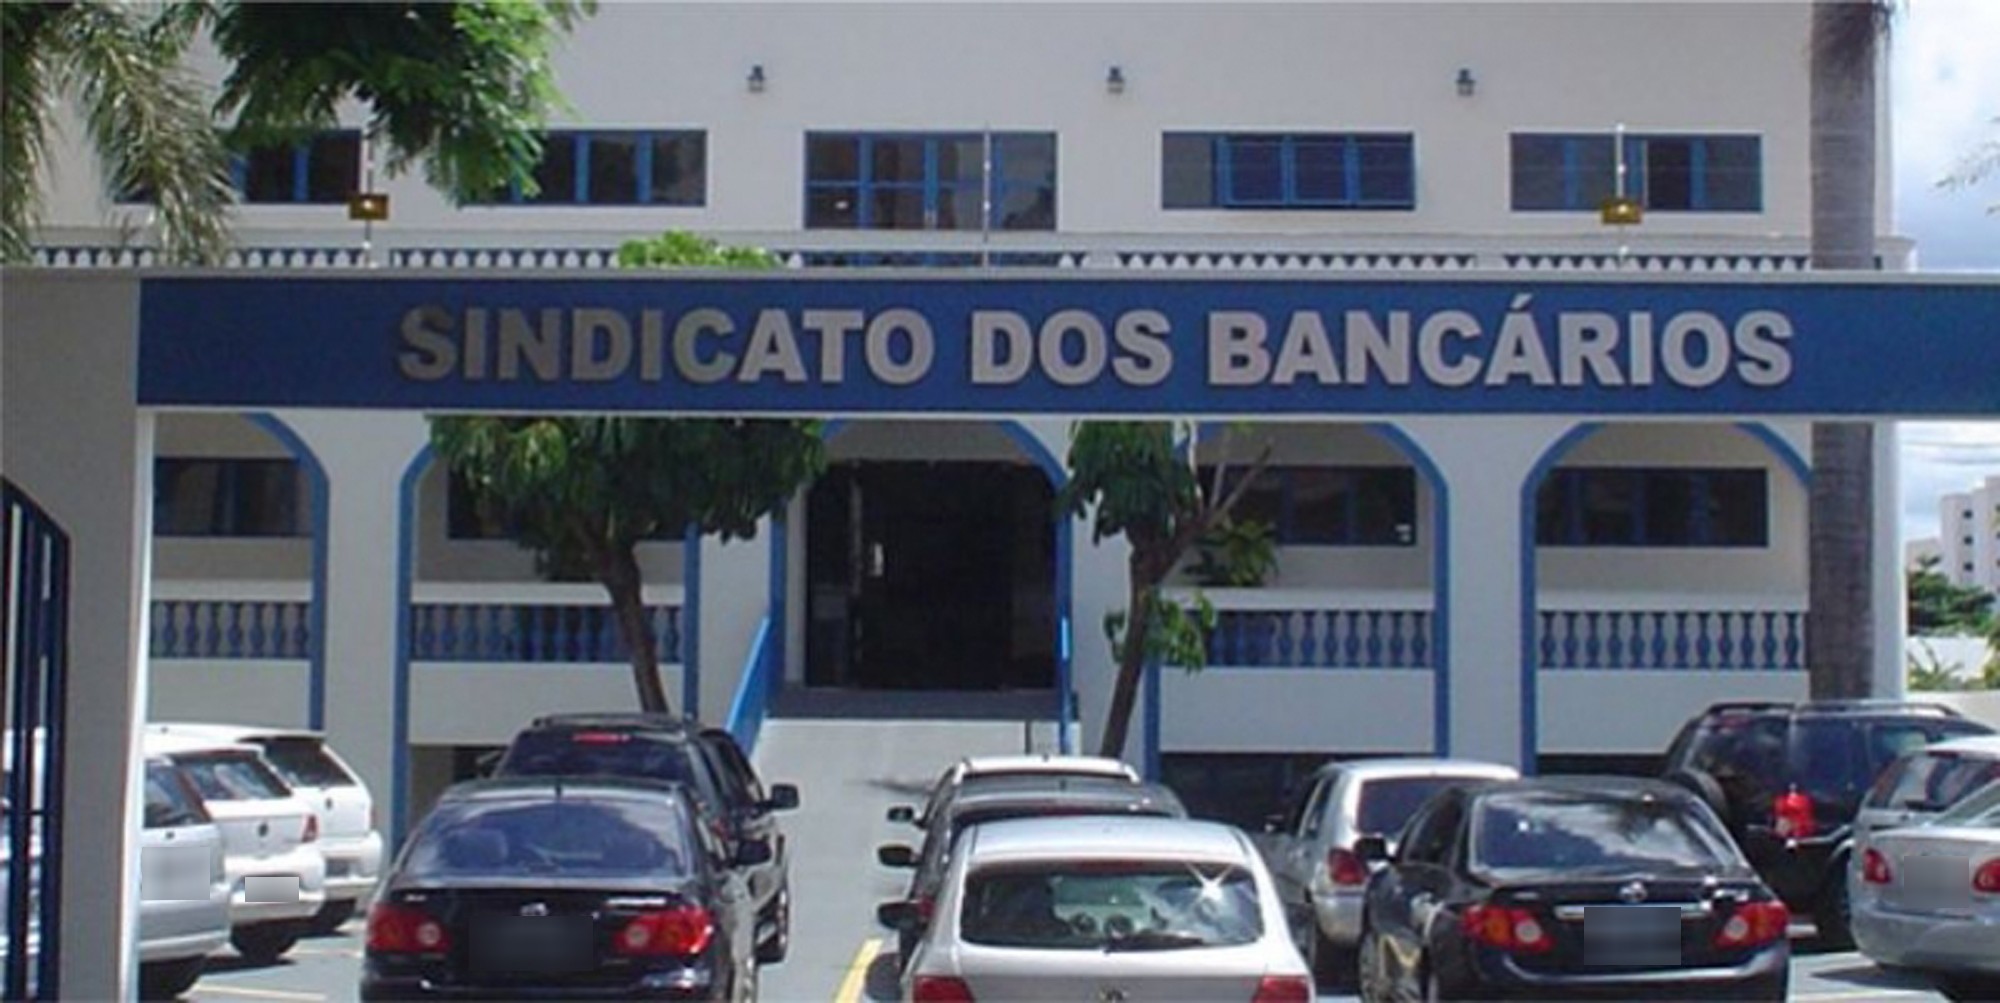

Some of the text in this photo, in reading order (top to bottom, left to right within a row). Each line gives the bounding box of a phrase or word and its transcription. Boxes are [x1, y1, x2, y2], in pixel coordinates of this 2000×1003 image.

[399, 294, 1794, 388] SINDICATO DOS BANCÁRIOS
